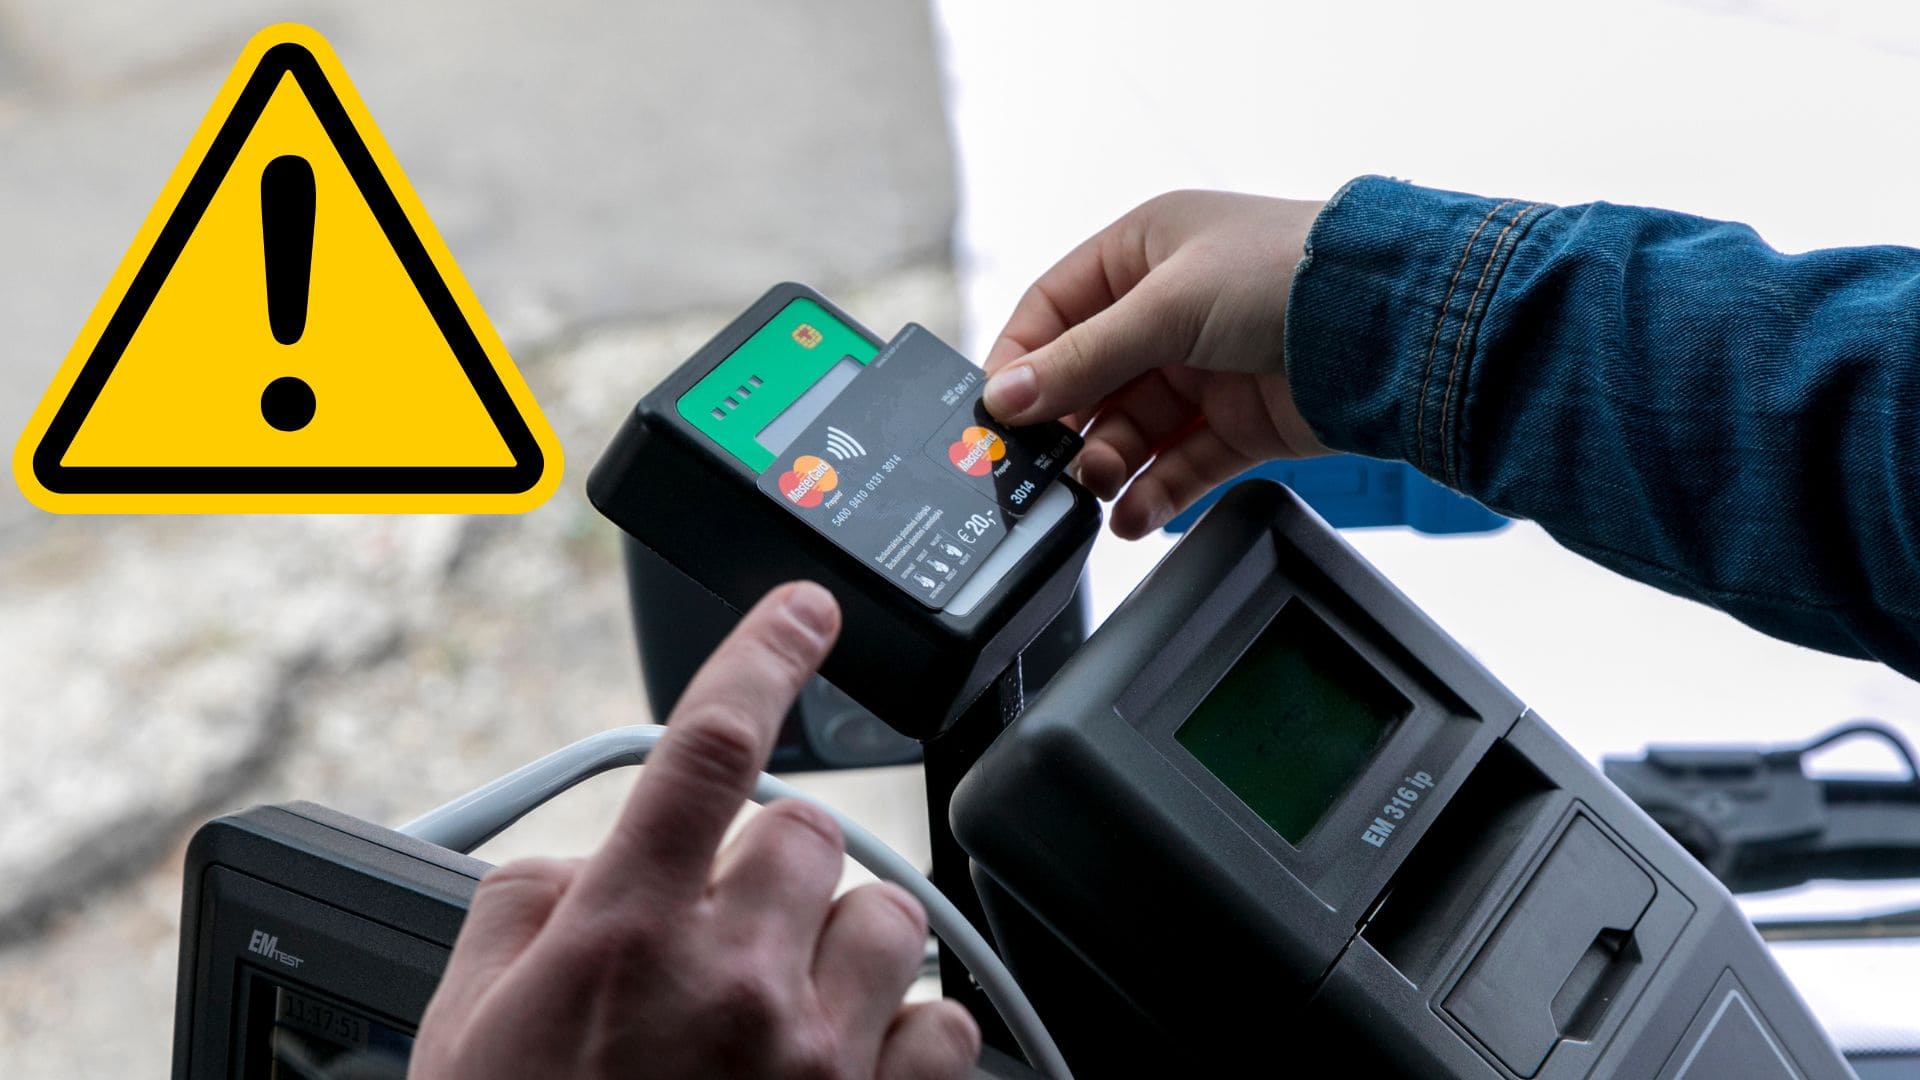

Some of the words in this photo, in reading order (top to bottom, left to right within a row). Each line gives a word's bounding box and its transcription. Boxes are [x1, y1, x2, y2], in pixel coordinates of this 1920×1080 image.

[954, 372, 977, 395] 06/17
[957, 430, 998, 472] MasterCard
[993, 459, 1012, 478] Prepaid
[787, 459, 831, 504] MasterCard
[824, 490, 843, 509] Prepaid
[831, 508, 852, 527] 5400
[849, 490, 868, 509] 9410
[865, 472, 885, 491] 0131
[882, 454, 902, 473] 3014
[1010, 480, 1035, 504] 3014
[1361, 817, 1396, 848] EM
[1383, 787, 1418, 819] 316
[1405, 771, 1435, 790] ip
[286, 995, 361, 1042] 11:17:51
